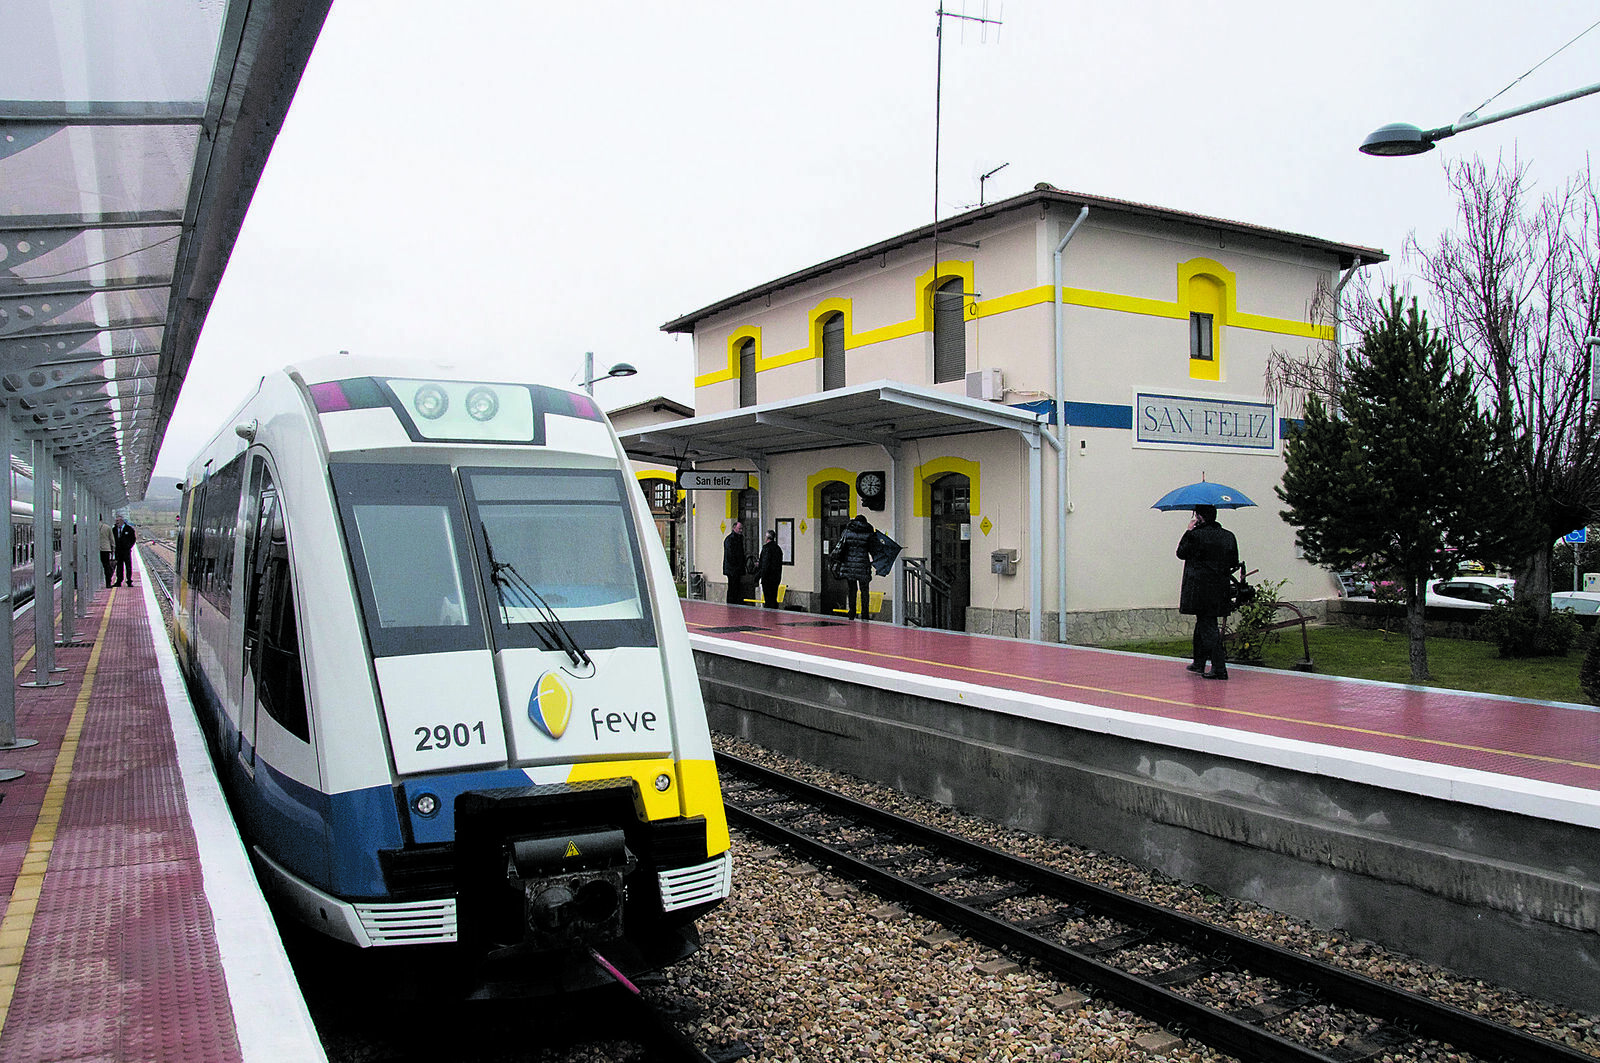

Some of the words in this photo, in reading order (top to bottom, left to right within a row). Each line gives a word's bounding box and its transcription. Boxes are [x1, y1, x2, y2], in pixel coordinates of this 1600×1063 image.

[1144, 405, 1193, 434] SAN
[1204, 410, 1268, 438] FELIZ
[695, 476, 711, 486] San
[713, 475, 731, 486] feliz
[414, 720, 487, 752] 2901
[590, 707, 657, 741] feve
